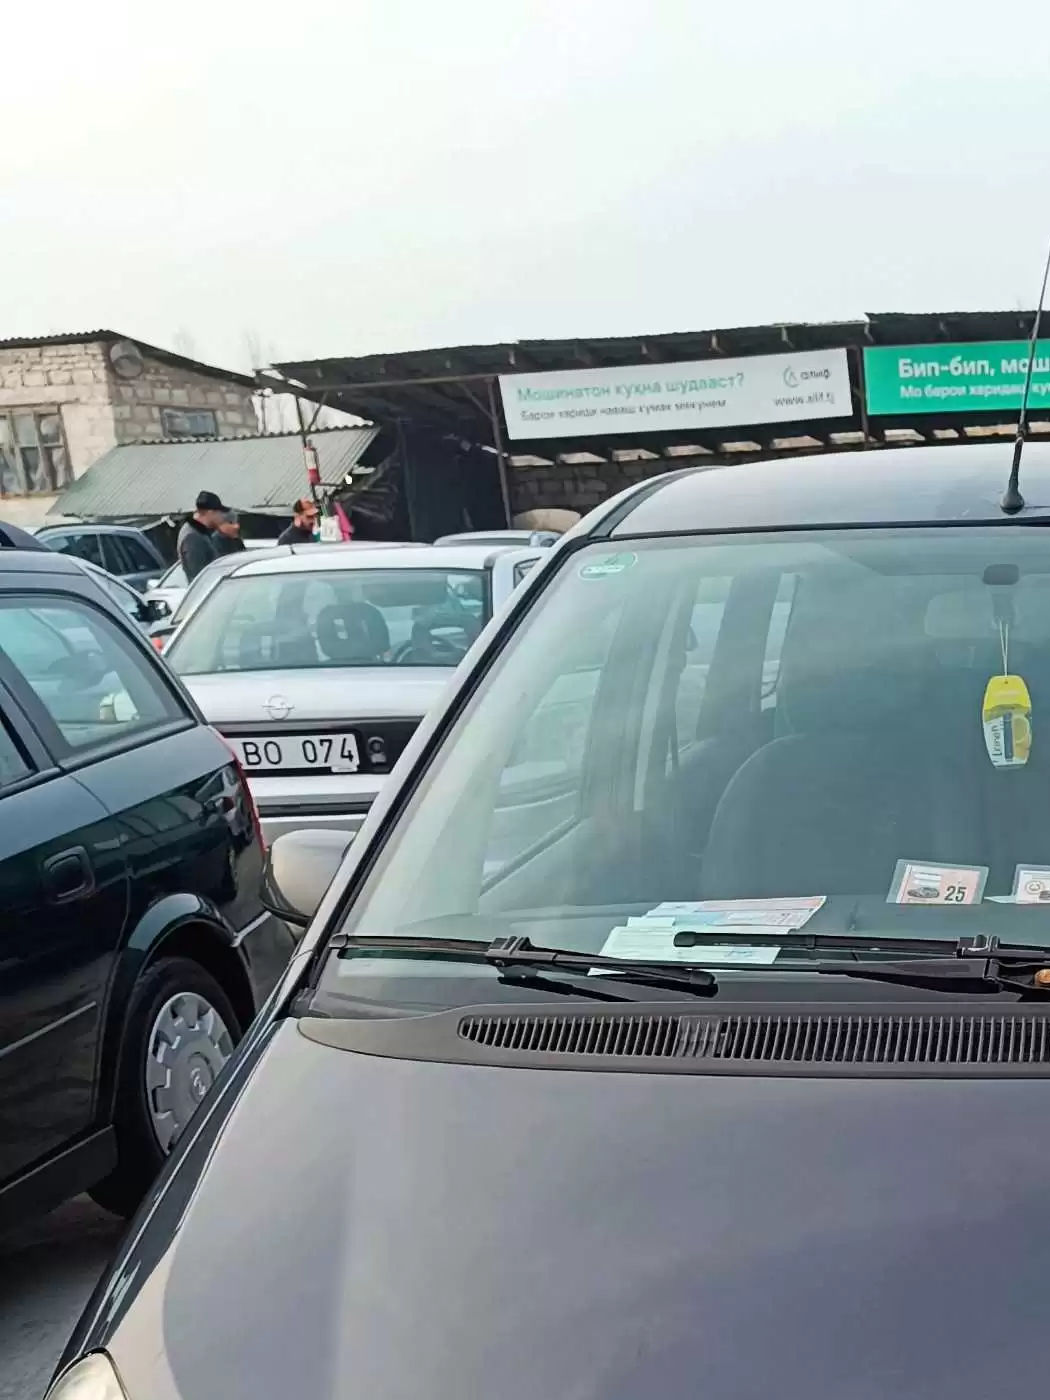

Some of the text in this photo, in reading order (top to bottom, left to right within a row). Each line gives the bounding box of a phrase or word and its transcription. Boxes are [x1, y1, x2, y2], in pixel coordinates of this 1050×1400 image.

[898, 356, 995, 378] Бип-бип,
[302, 737, 354, 763] 074
[944, 885, 967, 903] 25
